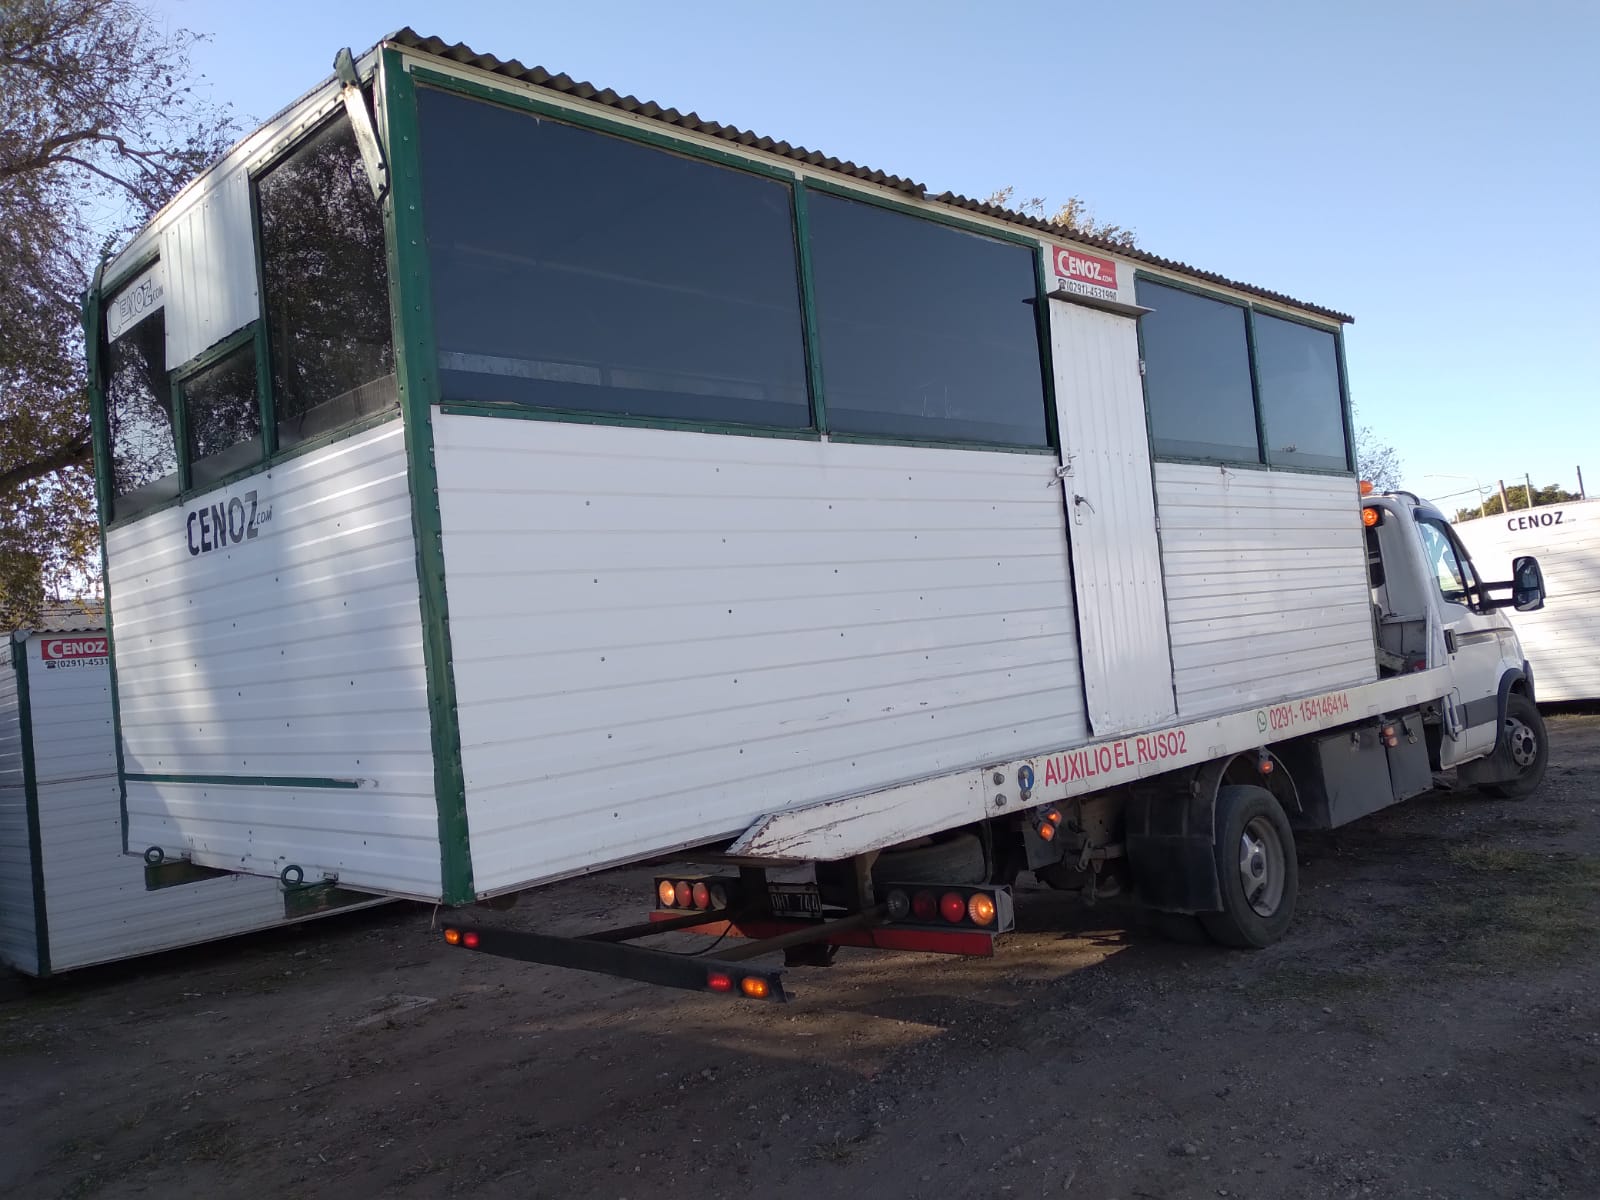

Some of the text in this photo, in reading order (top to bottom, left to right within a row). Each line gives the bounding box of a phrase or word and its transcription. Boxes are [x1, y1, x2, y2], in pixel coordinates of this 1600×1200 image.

[47, 641, 106, 658] CENOZ
[1045, 730, 1187, 786] AUXILIO EL RUSO2
